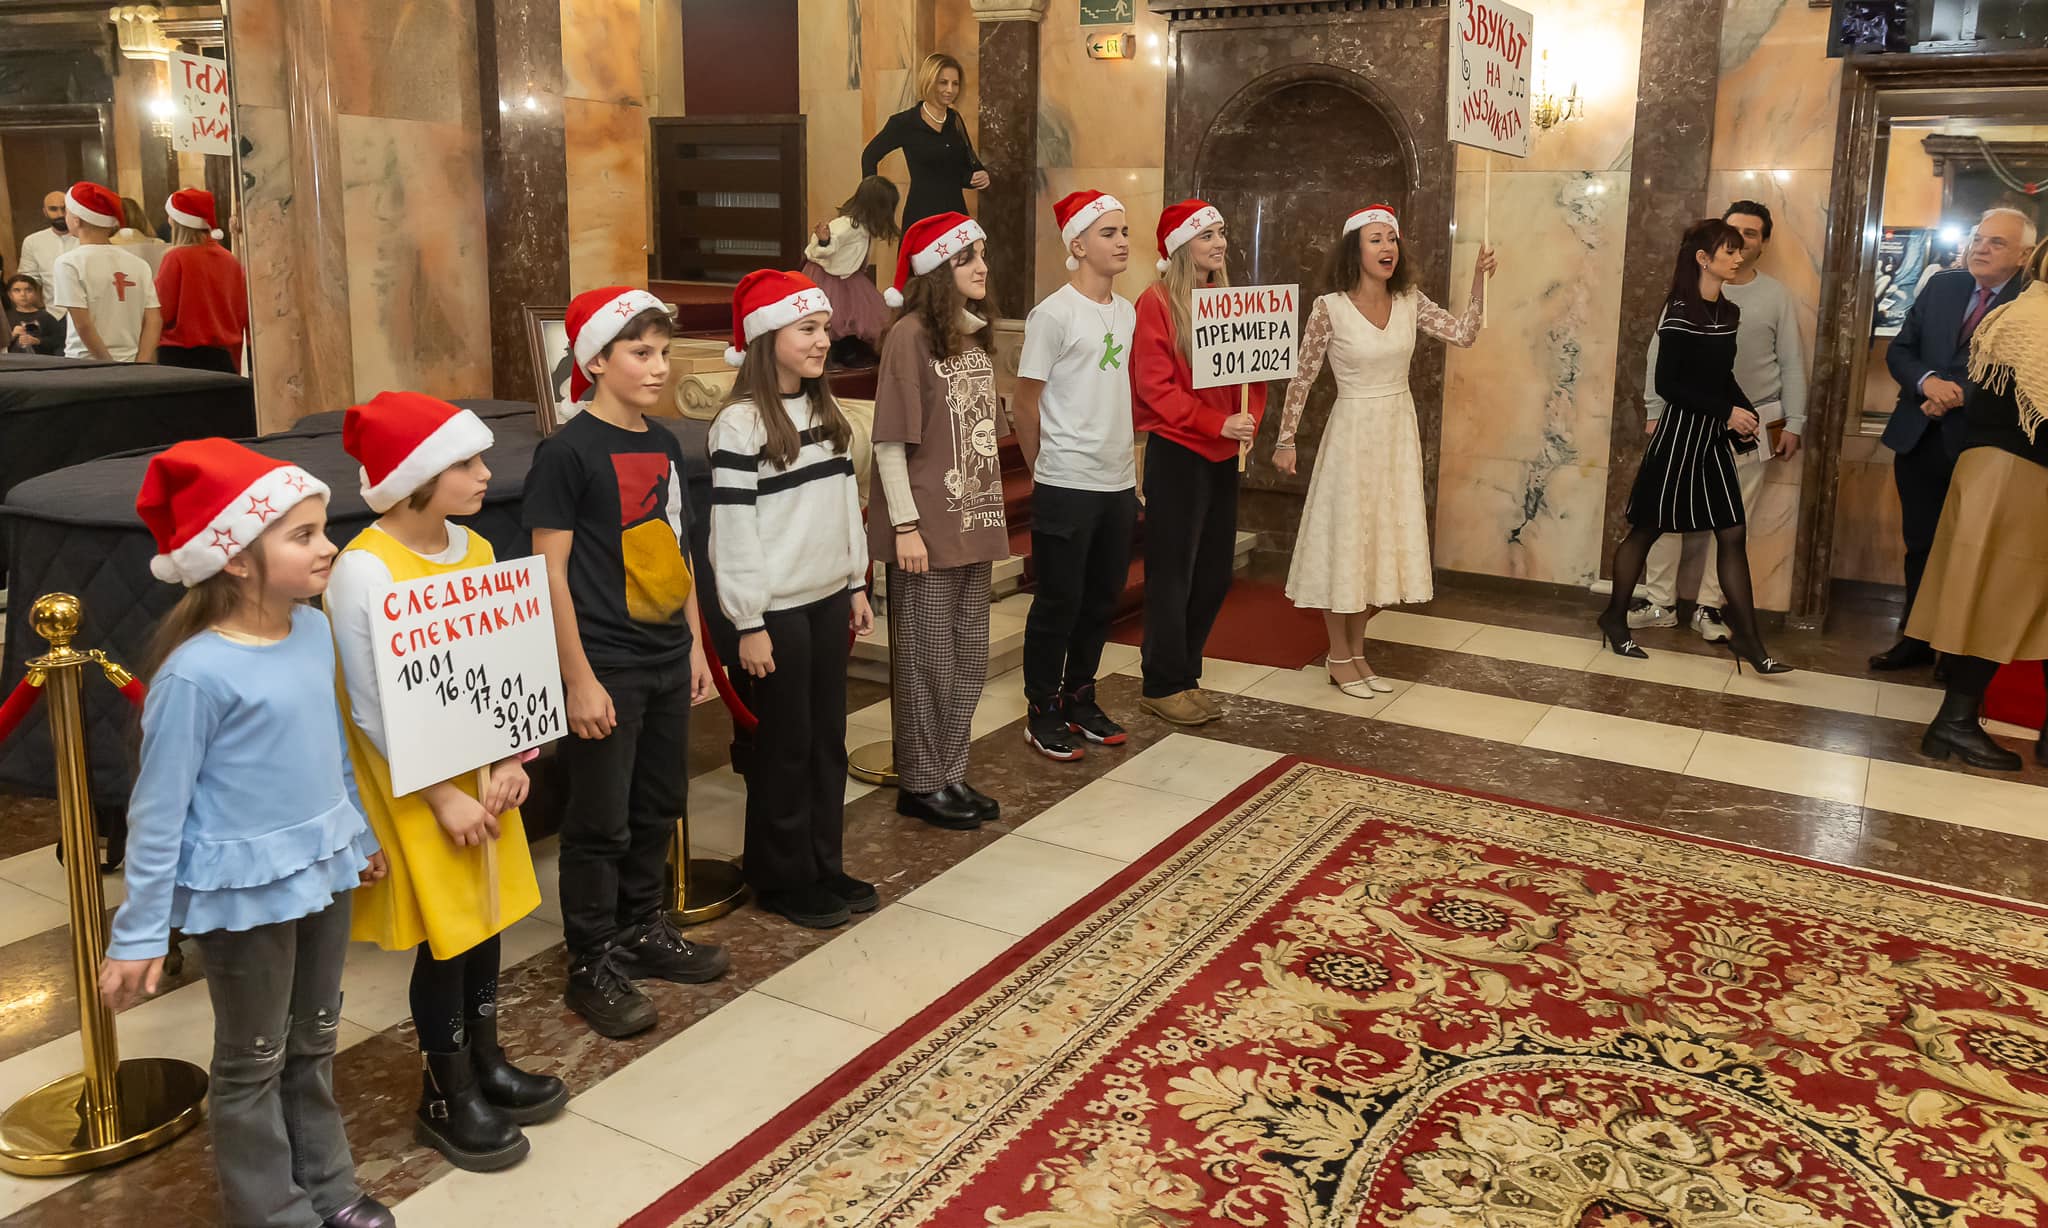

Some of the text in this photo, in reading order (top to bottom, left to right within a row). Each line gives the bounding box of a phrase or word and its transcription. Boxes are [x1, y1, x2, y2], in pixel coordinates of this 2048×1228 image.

[1464, 0, 1527, 69] ЗВУКЪТ
[1486, 61, 1501, 88] НА
[1463, 89, 1522, 141] МУЗИКАТА
[1198, 289, 1293, 320] МЮЗИКЪЛ
[1196, 320, 1291, 349] ПРЕМИЕРА
[1213, 346, 1290, 377] 9.01.2024
[384, 568, 530, 621] СЛЕДВАЩИ
[391, 597, 541, 656] СПЕКТАКЛИ
[398, 650, 454, 691] 10.01
[436, 664, 486, 706] 16.01
[471, 673, 524, 714] 17.01
[494, 686, 549, 728] 30.01
[510, 707, 560, 748] 31.01
